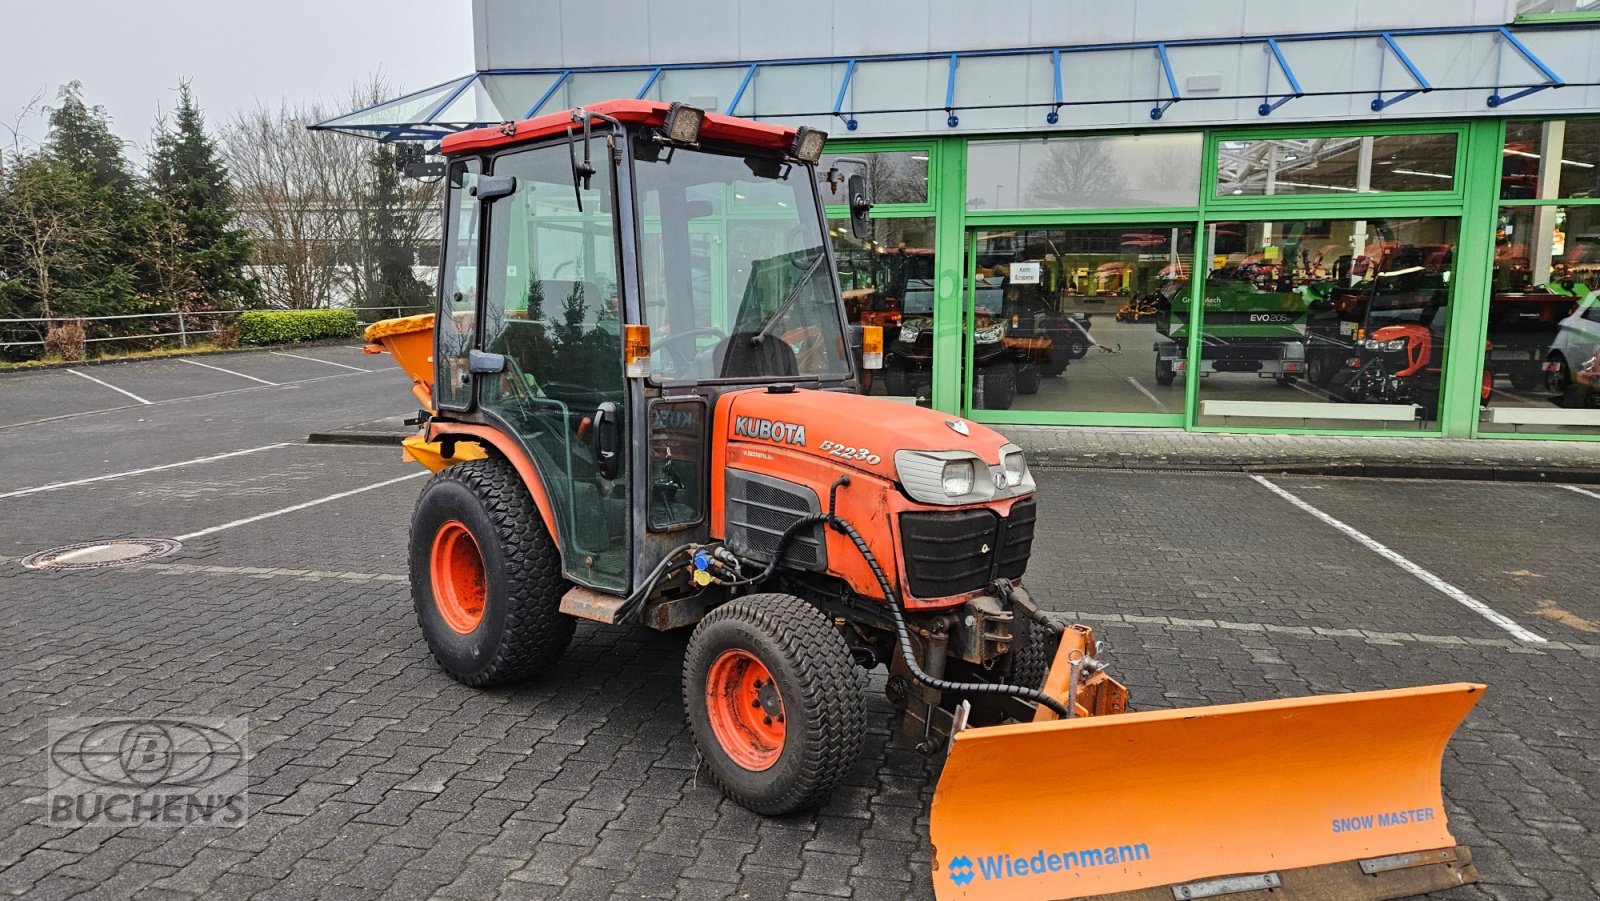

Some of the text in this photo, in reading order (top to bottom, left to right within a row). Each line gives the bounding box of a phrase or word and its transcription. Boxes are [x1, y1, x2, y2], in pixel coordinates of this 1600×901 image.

[1250, 314, 1270, 322] EVO
[735, 415, 806, 446] KUBOTA
[819, 440, 881, 465] B2230
[1332, 807, 1434, 833] SNOW MASTER
[977, 843, 1150, 881] Wiedenmann
